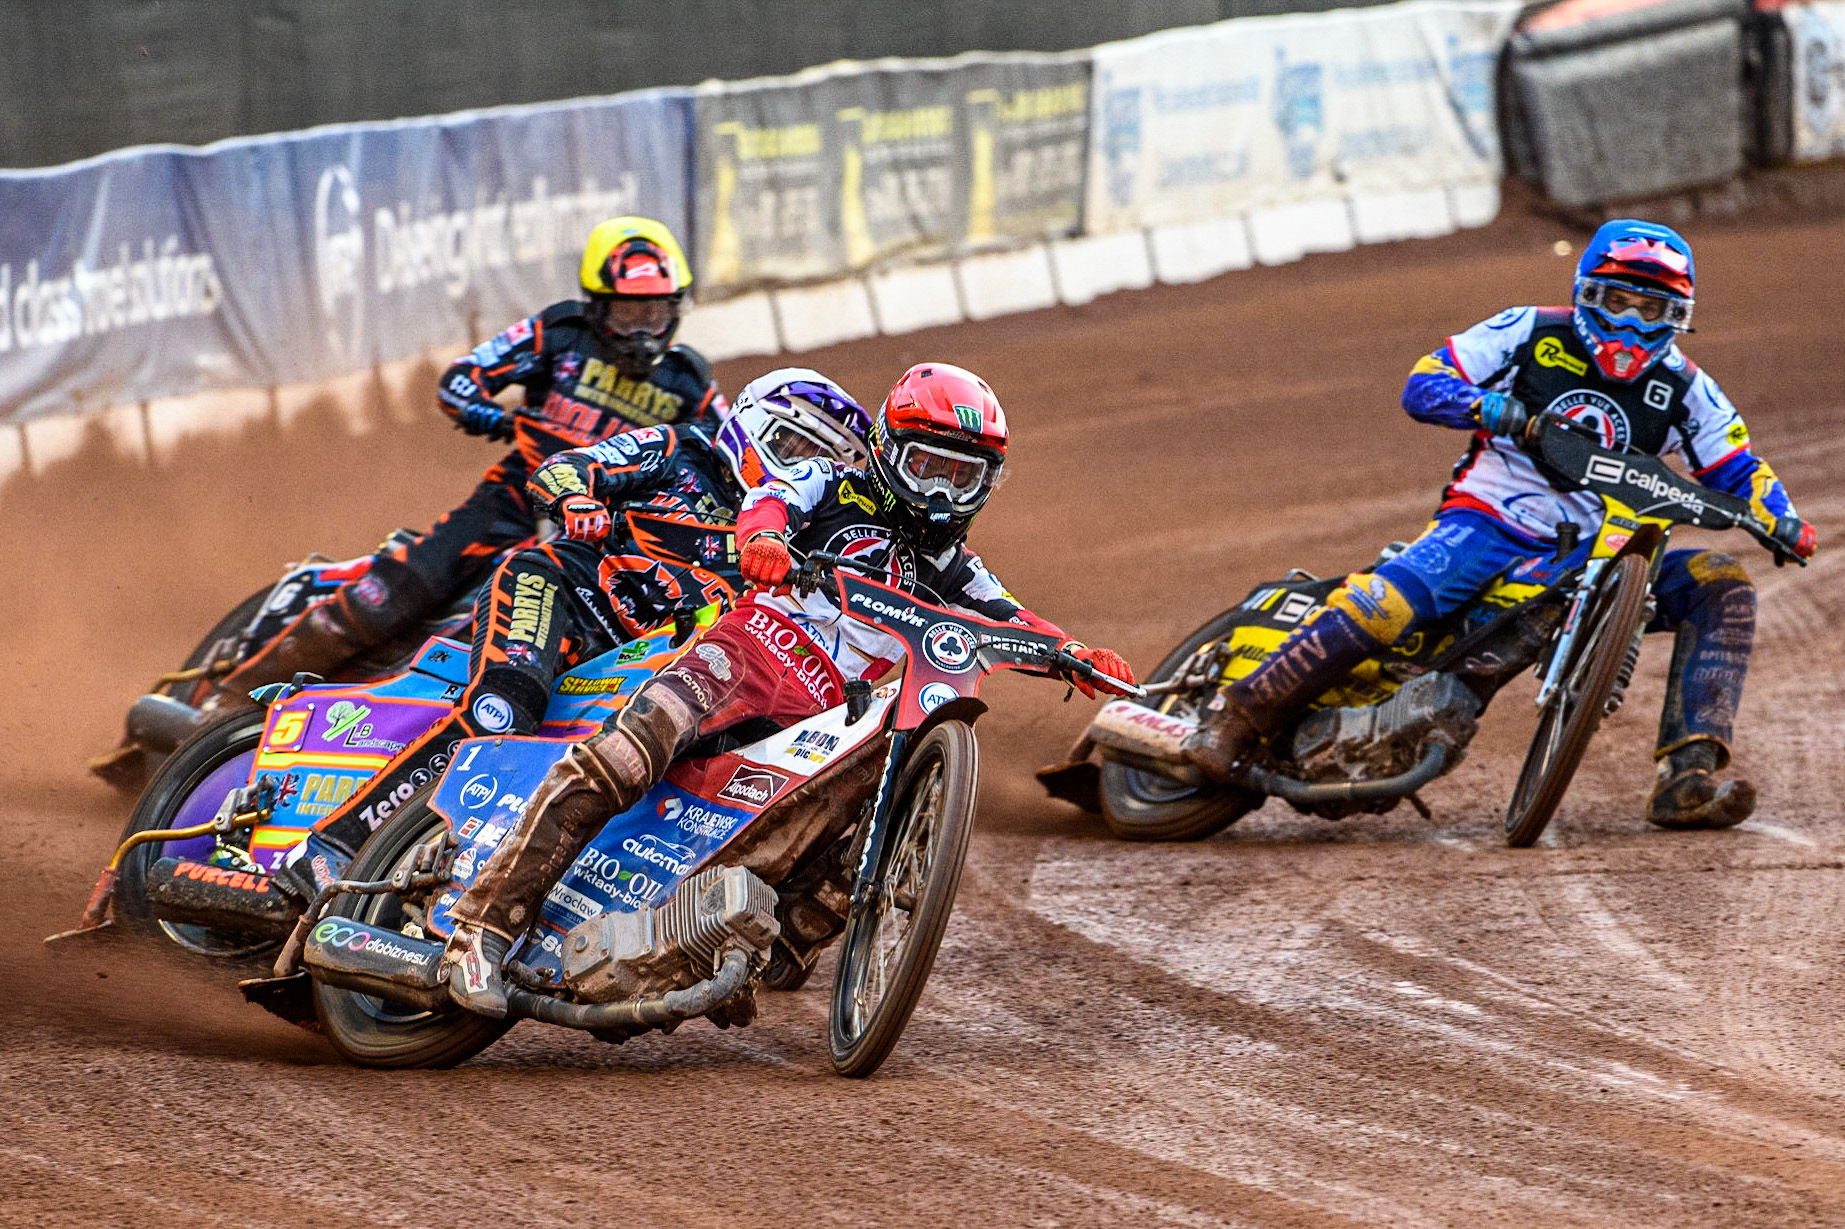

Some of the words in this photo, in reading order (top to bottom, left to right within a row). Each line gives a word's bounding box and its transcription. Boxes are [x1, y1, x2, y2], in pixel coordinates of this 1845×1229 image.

[1554, 394, 1585, 414] BELLE
[1591, 395, 1612, 413] VUE
[1610, 413, 1627, 441] ACES
[1624, 467, 1705, 516] calpeda
[842, 530, 878, 541] BELLE
[900, 555, 914, 587] ACES
[508, 572, 546, 644] PARRYS
[746, 609, 799, 651] BIO
[949, 624, 964, 634] VUE
[270, 711, 309, 746] 5
[481, 702, 505, 723] ATPI
[456, 745, 483, 772] 1
[467, 783, 490, 800] ATPI
[173, 861, 272, 893] PURCELL
[577, 847, 621, 881] BIO
